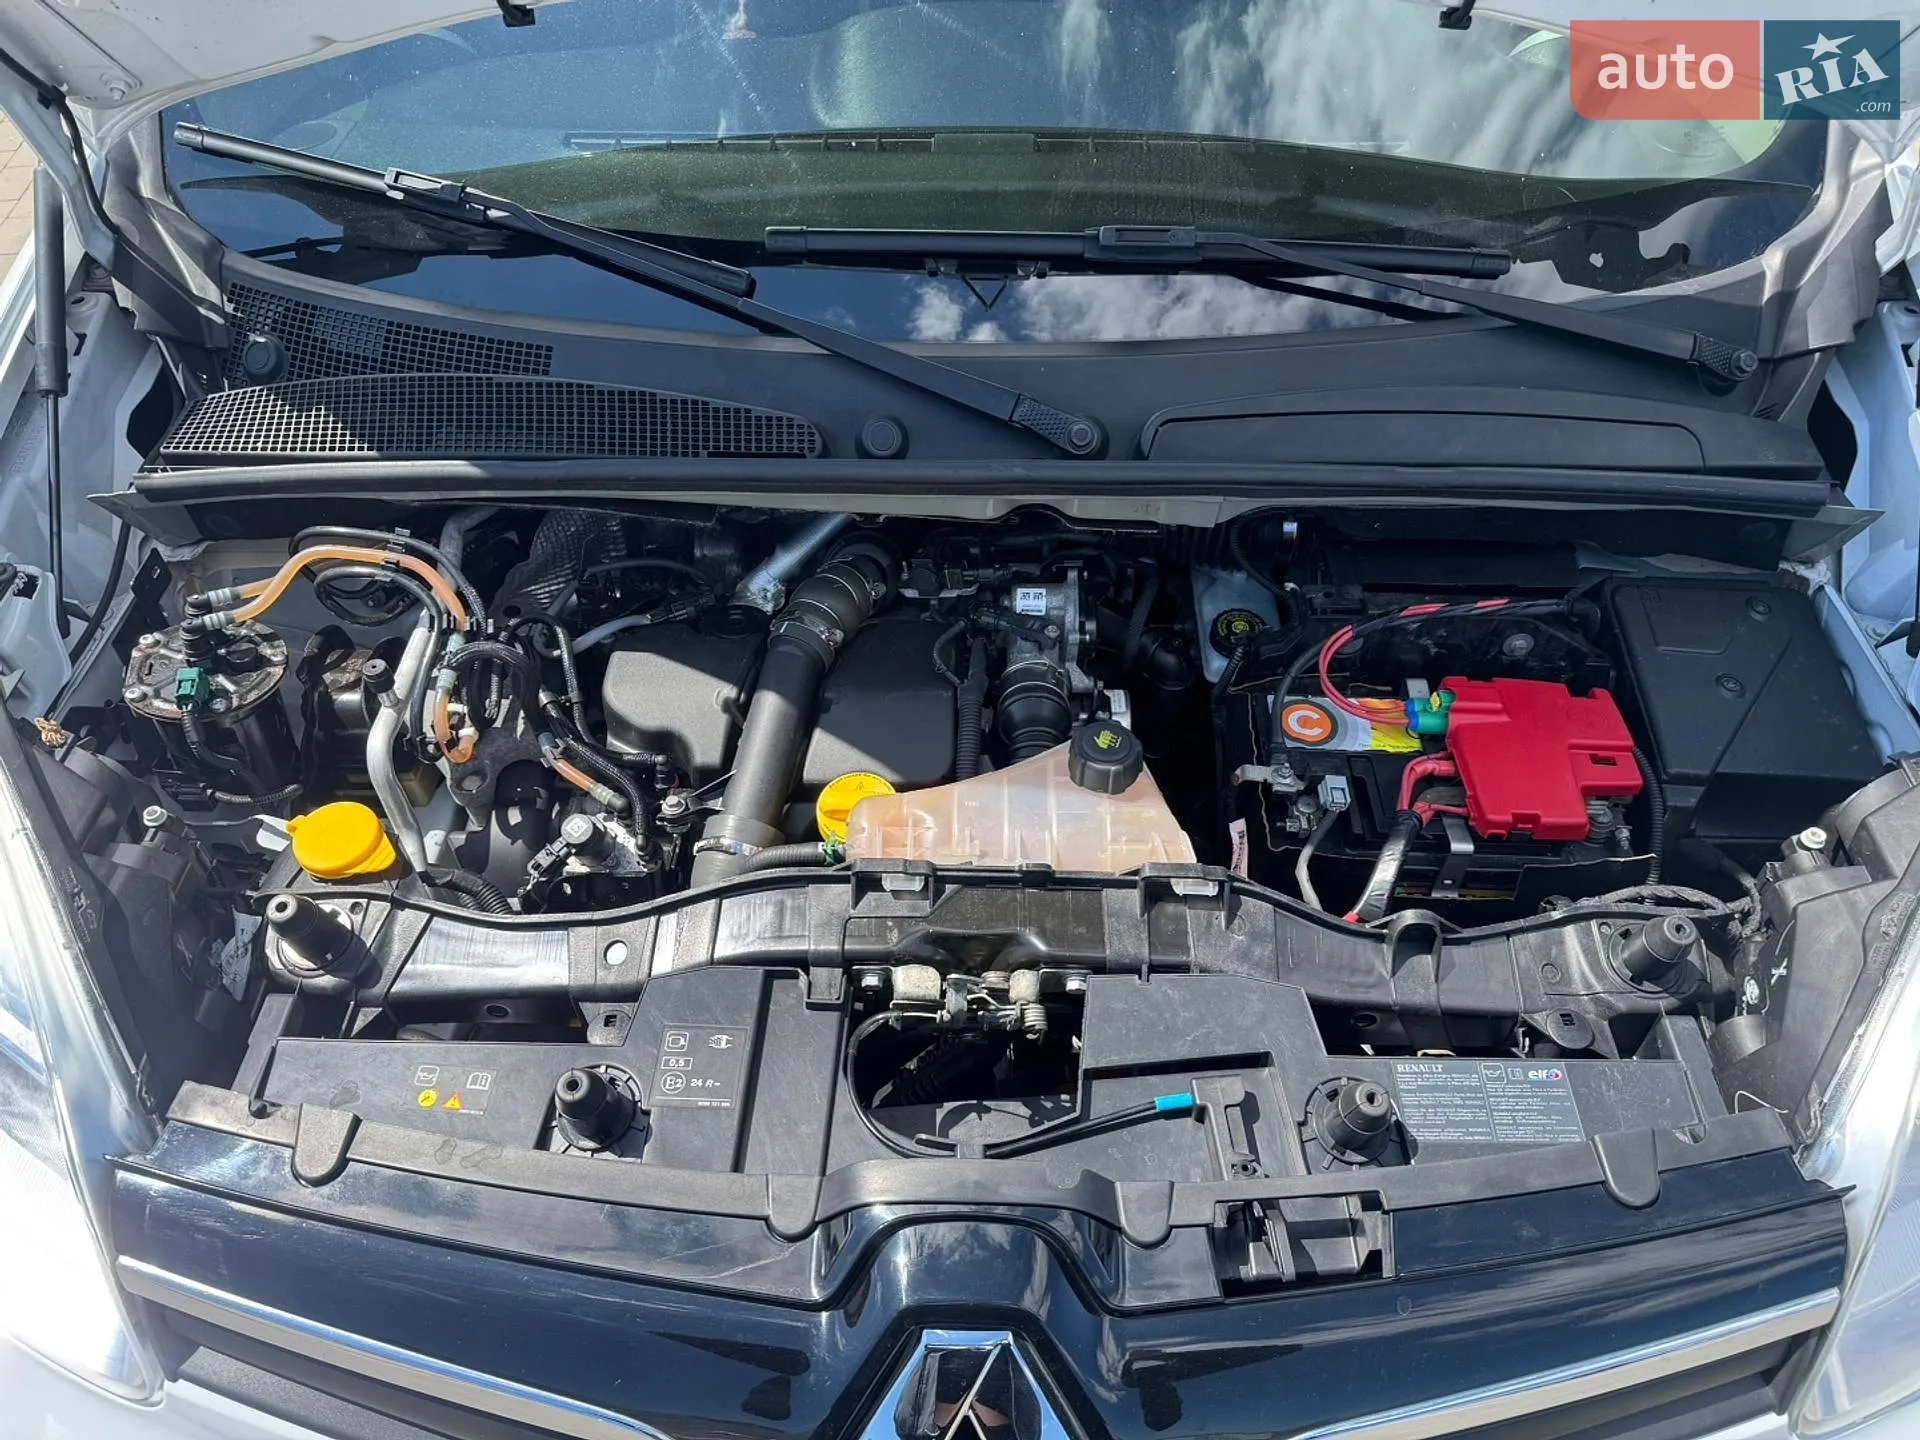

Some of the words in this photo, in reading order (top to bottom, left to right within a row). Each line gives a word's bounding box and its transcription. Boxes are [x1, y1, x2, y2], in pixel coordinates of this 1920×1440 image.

[1397, 1063, 1443, 1073] RENAULT
[1528, 1069, 1548, 1080] elf
[665, 1076, 683, 1090] E2
